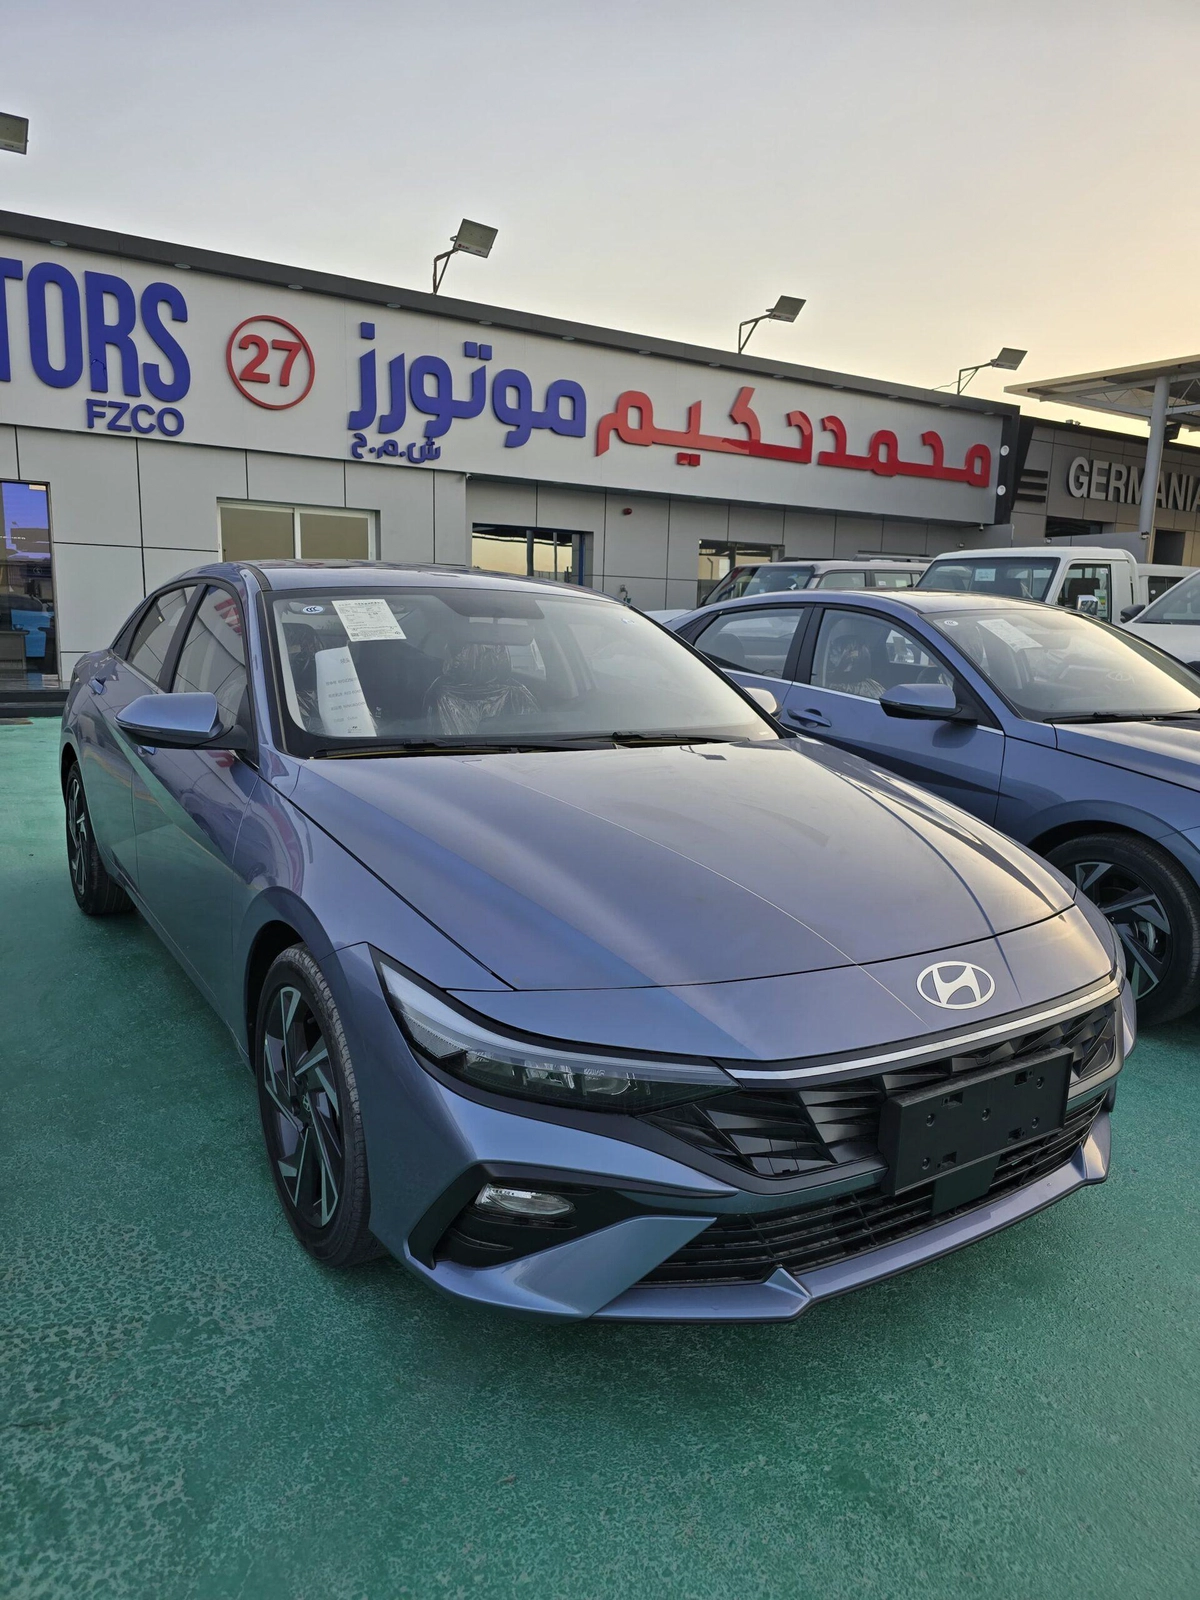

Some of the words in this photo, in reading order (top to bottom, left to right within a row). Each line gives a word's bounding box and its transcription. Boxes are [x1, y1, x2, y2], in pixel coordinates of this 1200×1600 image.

[238, 334, 303, 388] 27
[348, 321, 587, 448] موتورز
[86, 398, 185, 437] FZCO
